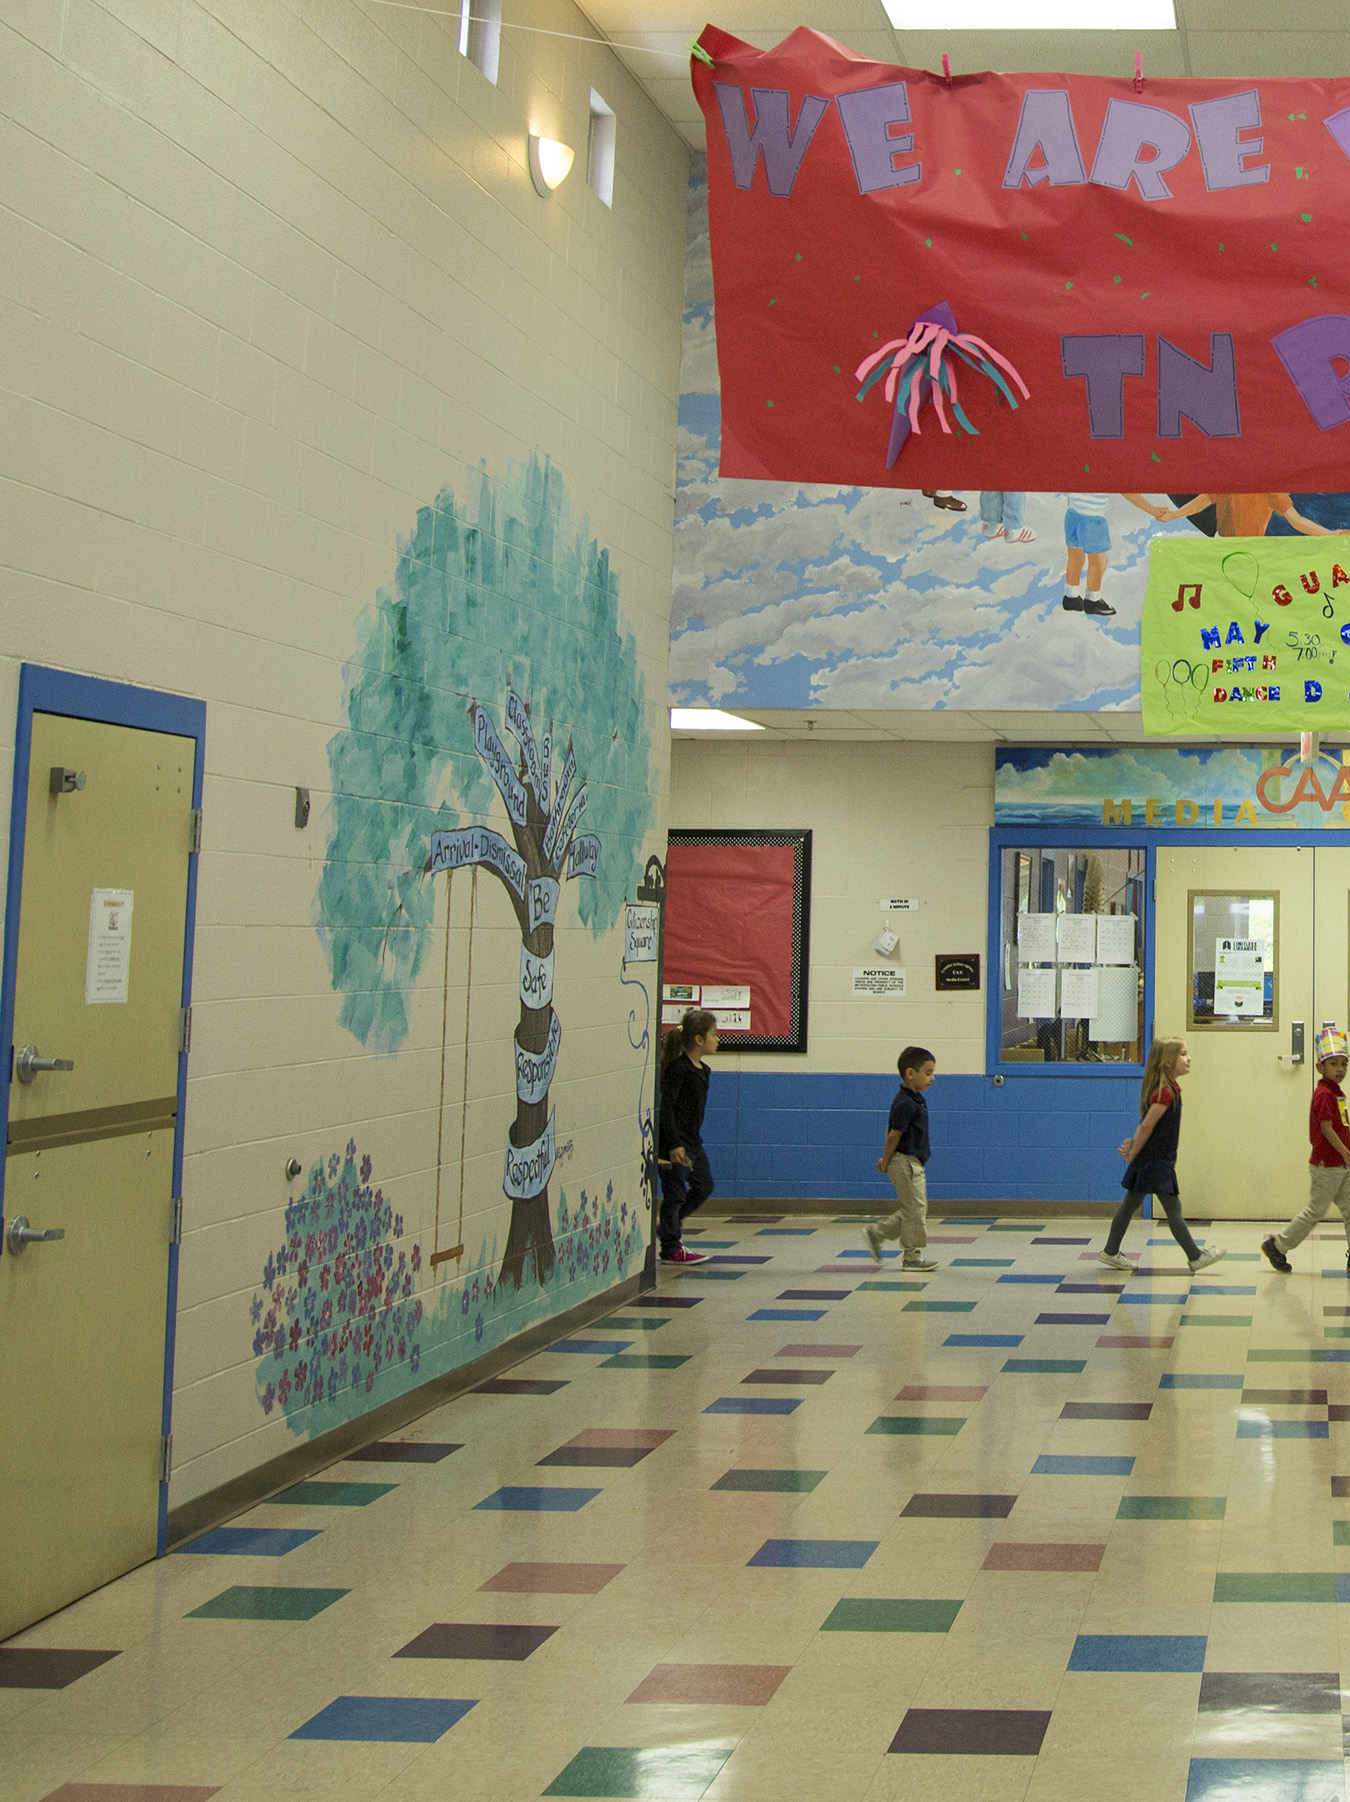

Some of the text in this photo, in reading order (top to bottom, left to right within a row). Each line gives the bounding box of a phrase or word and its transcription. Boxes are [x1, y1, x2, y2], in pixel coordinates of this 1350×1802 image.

[713, 81, 921, 199] WE
[1002, 89, 1270, 200] ARE
[1060, 332, 1242, 439] TN
[1200, 620, 1270, 652] MAY
[1212, 655, 1277, 675] FIFTH
[1213, 686, 1281, 703] DANCE
[478, 714, 525, 821] Playground
[1102, 798, 1260, 826] MEDIA
[569, 840, 599, 872] Hallway
[533, 883, 551, 921] Be
[523, 960, 549, 999] Safe
[506, 1134, 550, 1191] Respectful
